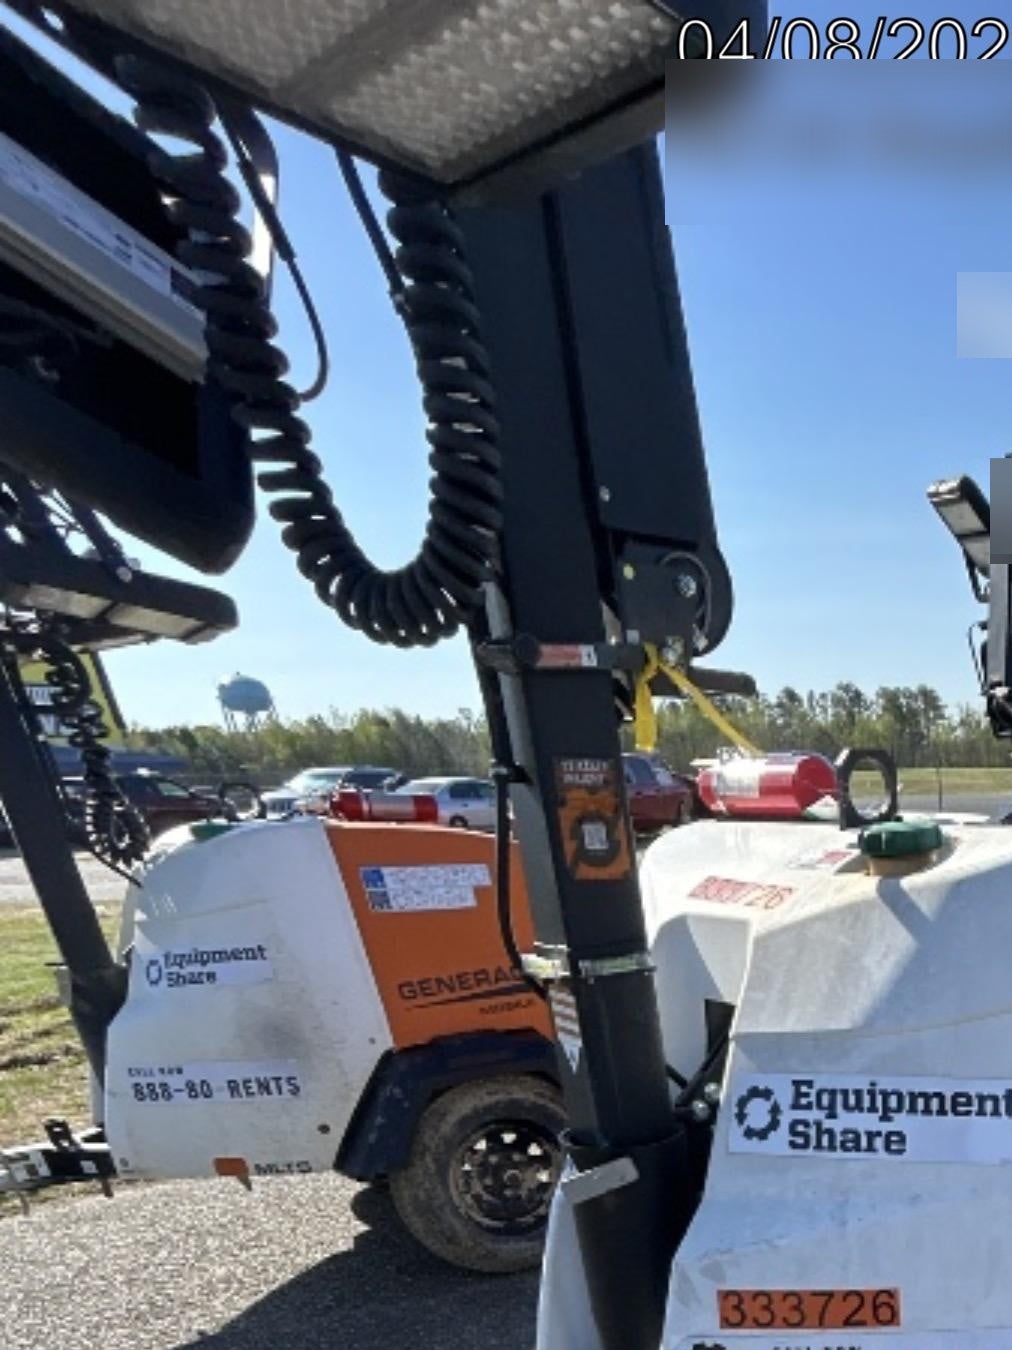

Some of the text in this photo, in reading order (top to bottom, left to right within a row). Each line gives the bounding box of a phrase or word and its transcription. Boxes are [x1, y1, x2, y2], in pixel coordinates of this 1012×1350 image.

[163, 944, 268, 969] Equipment
[166, 970, 216, 988] Share
[788, 1118, 907, 1155] Share
[722, 1290, 899, 1328] 333726
